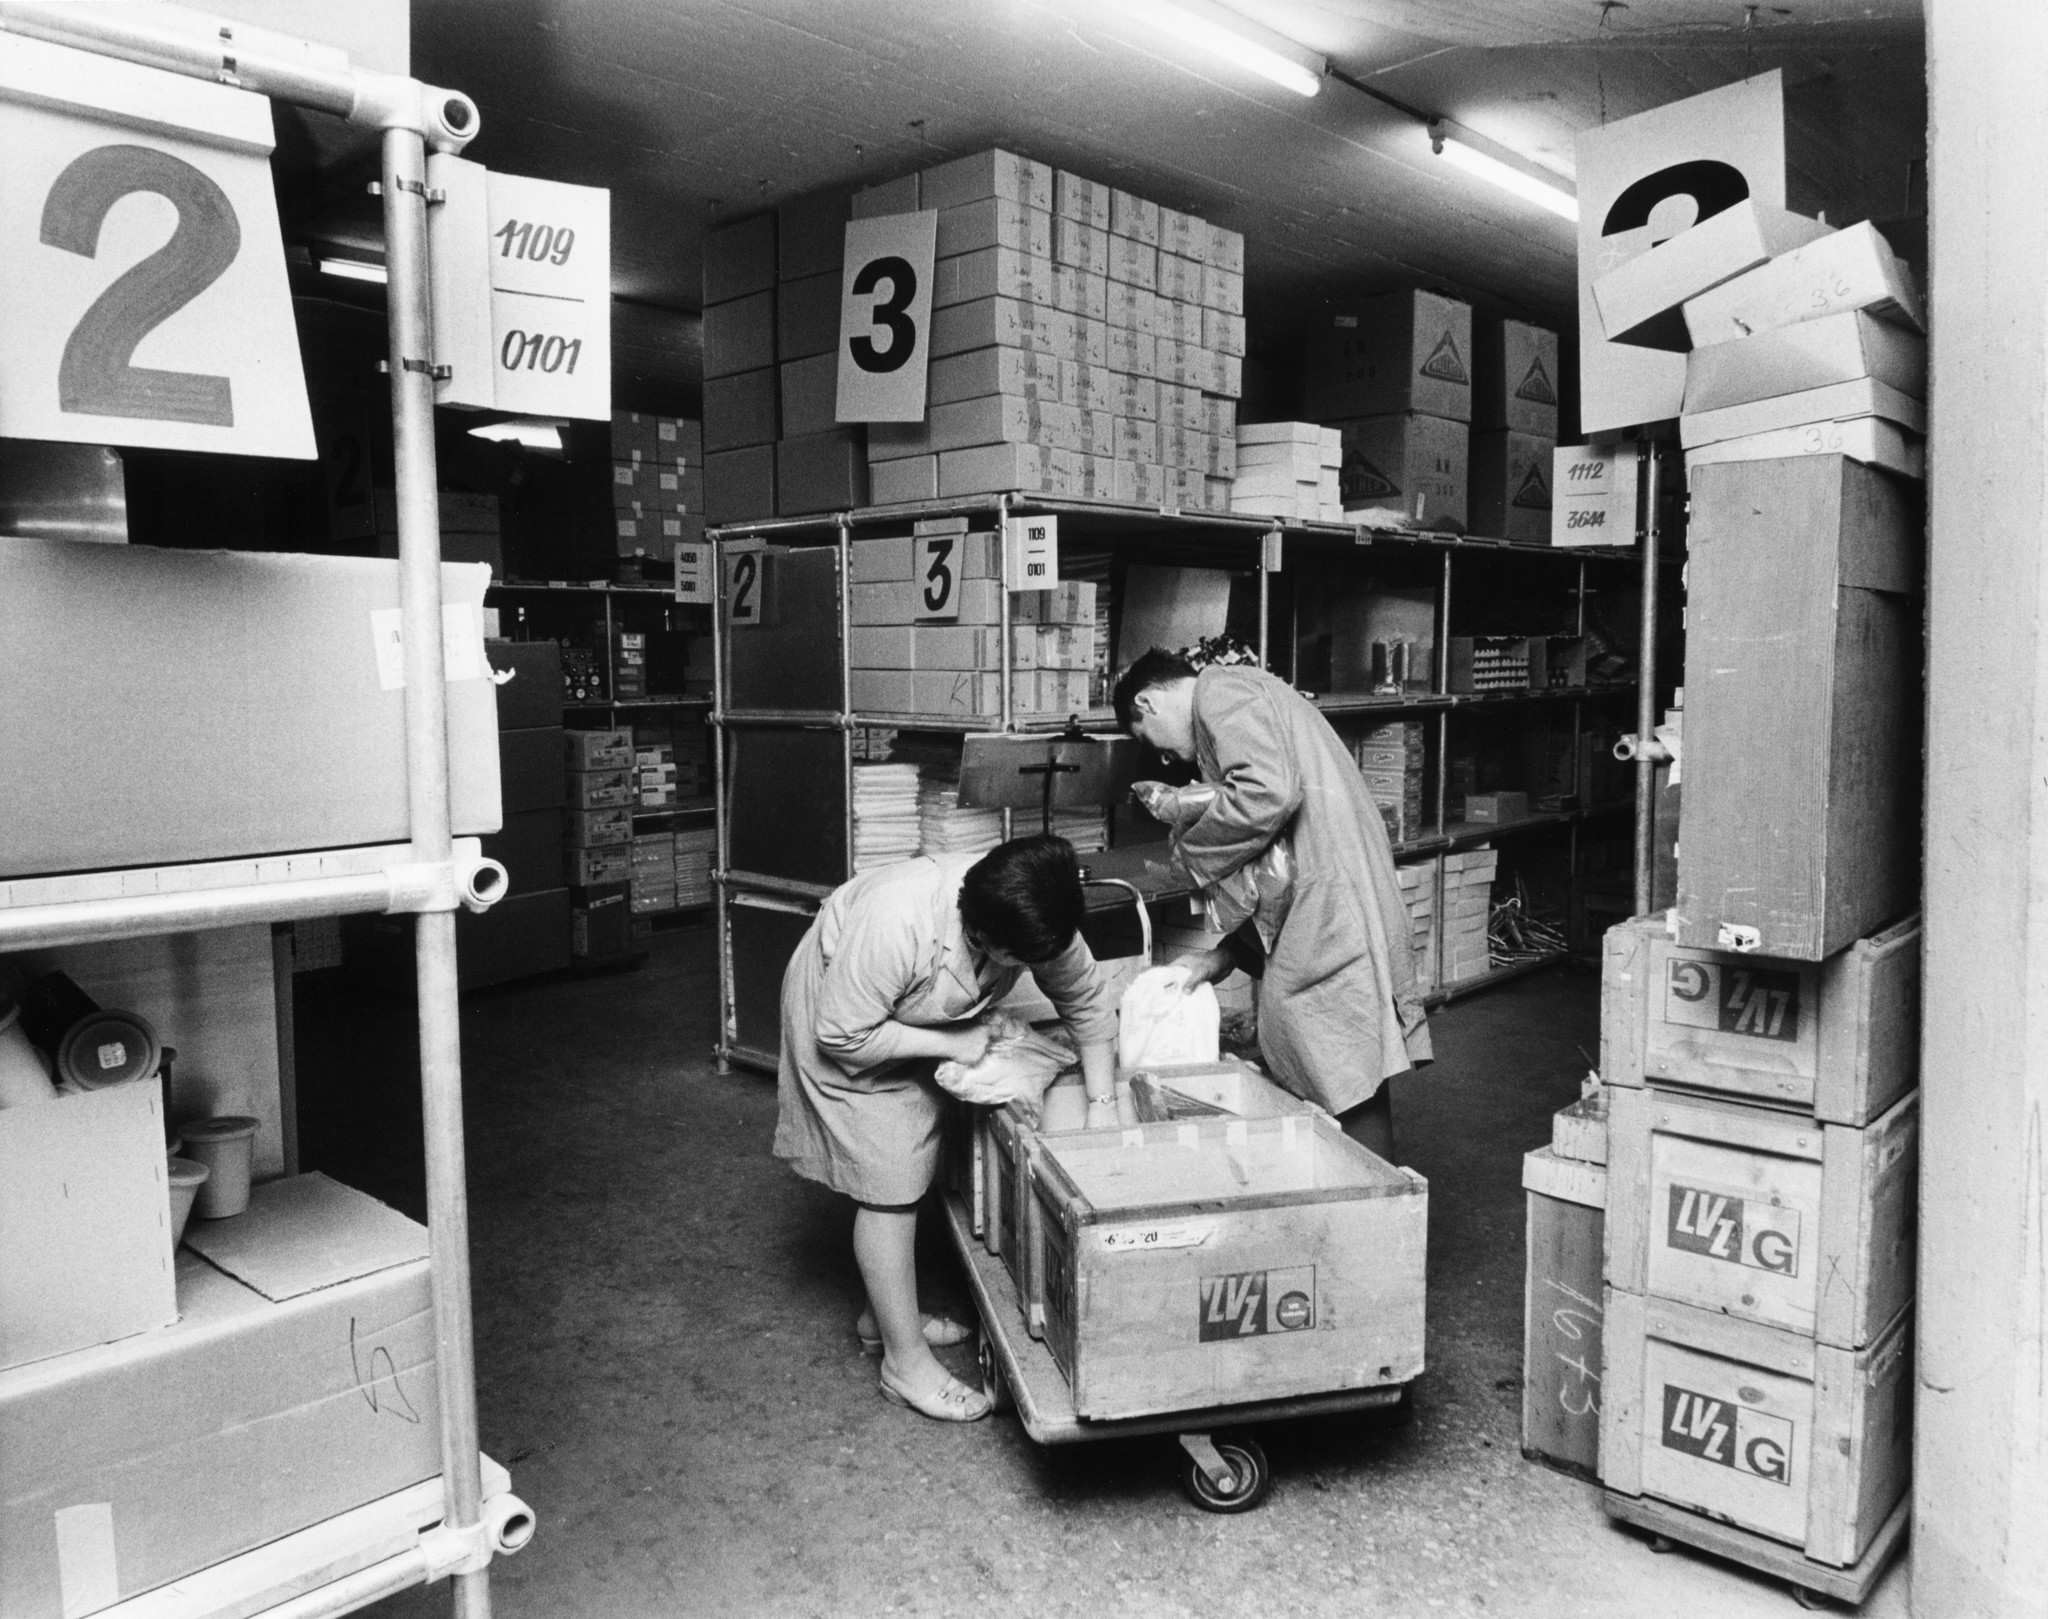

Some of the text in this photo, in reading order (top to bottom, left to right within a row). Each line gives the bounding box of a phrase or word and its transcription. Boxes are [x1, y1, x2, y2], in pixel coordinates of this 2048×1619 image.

[495, 218, 575, 266] 1109
[39, 143, 241, 428] 2
[849, 255, 917, 373] 3
[501, 328, 582, 375] 0101
[1568, 462, 1605, 481] 1112
[1028, 527, 1046, 541] 1109
[1567, 510, 1607, 530] 3644
[732, 553, 757, 618] 2
[924, 538, 955, 612] 3
[1027, 562, 1046, 577] 0101
[1671, 960, 1711, 1002] G
[1675, 1189, 1793, 1274] LVZ G
[1670, 1392, 1786, 1482] LVZ G
